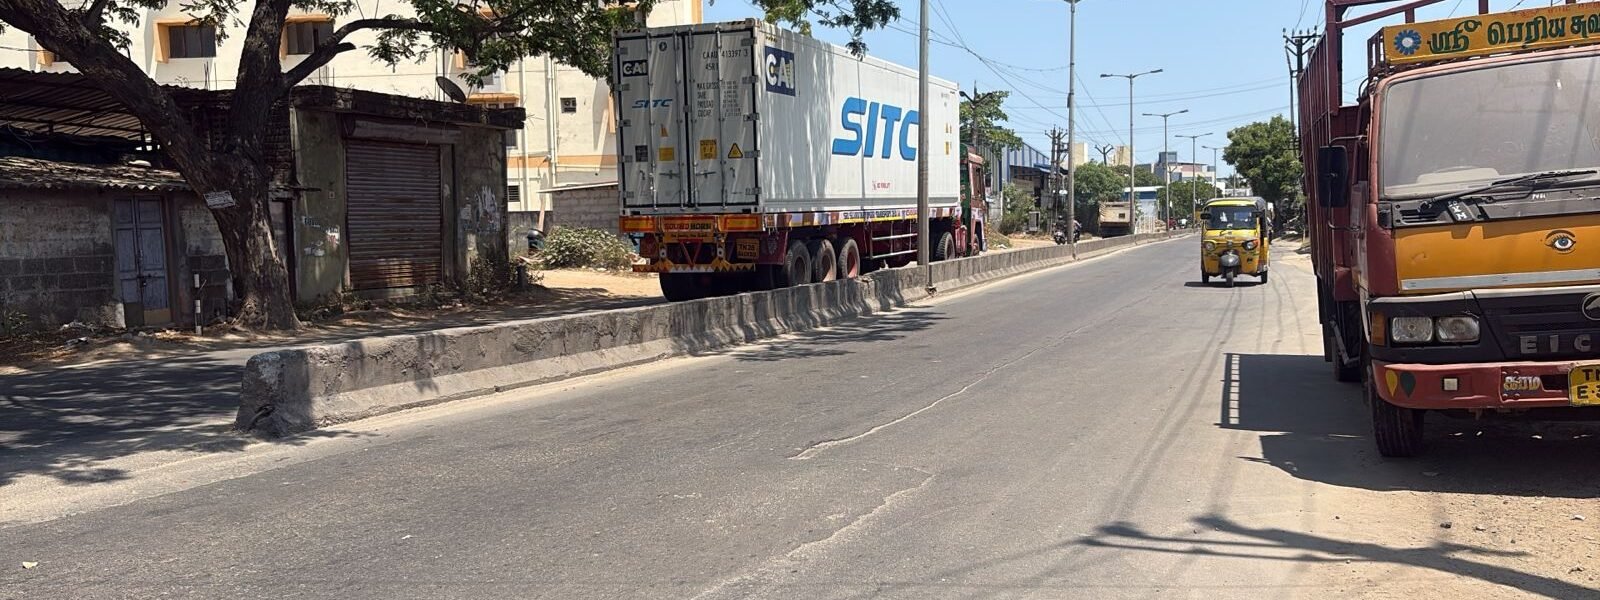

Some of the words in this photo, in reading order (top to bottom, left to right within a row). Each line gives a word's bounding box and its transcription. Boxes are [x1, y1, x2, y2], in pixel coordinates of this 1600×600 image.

[623, 62, 647, 75] CAI
[765, 54, 794, 89] CAI
[632, 99, 673, 108] SITC
[832, 97, 919, 161] SITC
[1520, 334, 1592, 354] EIC
